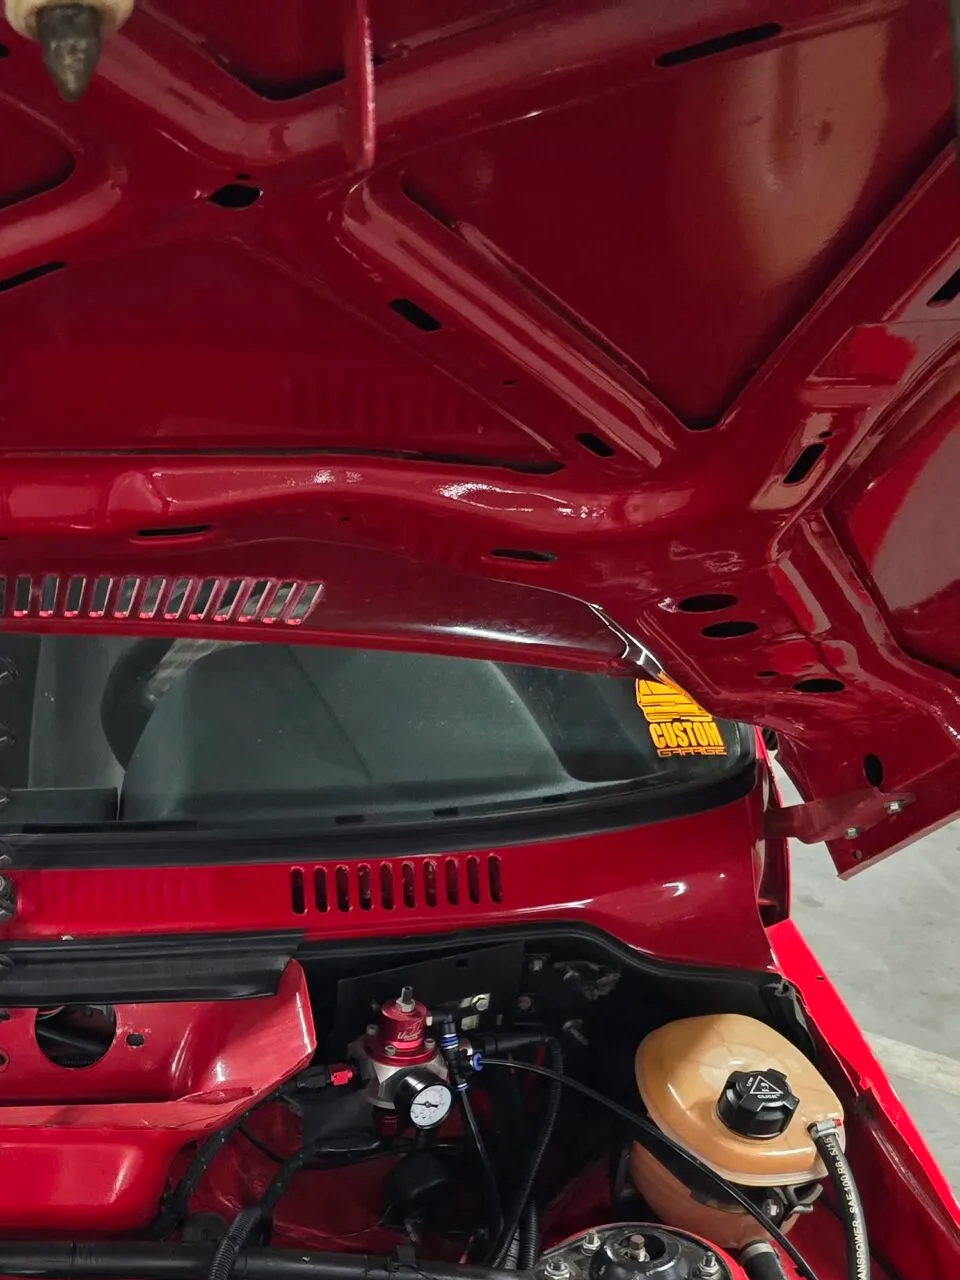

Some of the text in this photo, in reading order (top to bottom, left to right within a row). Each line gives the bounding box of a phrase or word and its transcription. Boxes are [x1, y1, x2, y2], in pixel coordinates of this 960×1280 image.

[648, 721, 724, 748] CUSTOM
[840, 1175, 853, 1192] 100
[845, 1192, 858, 1214] SAE
